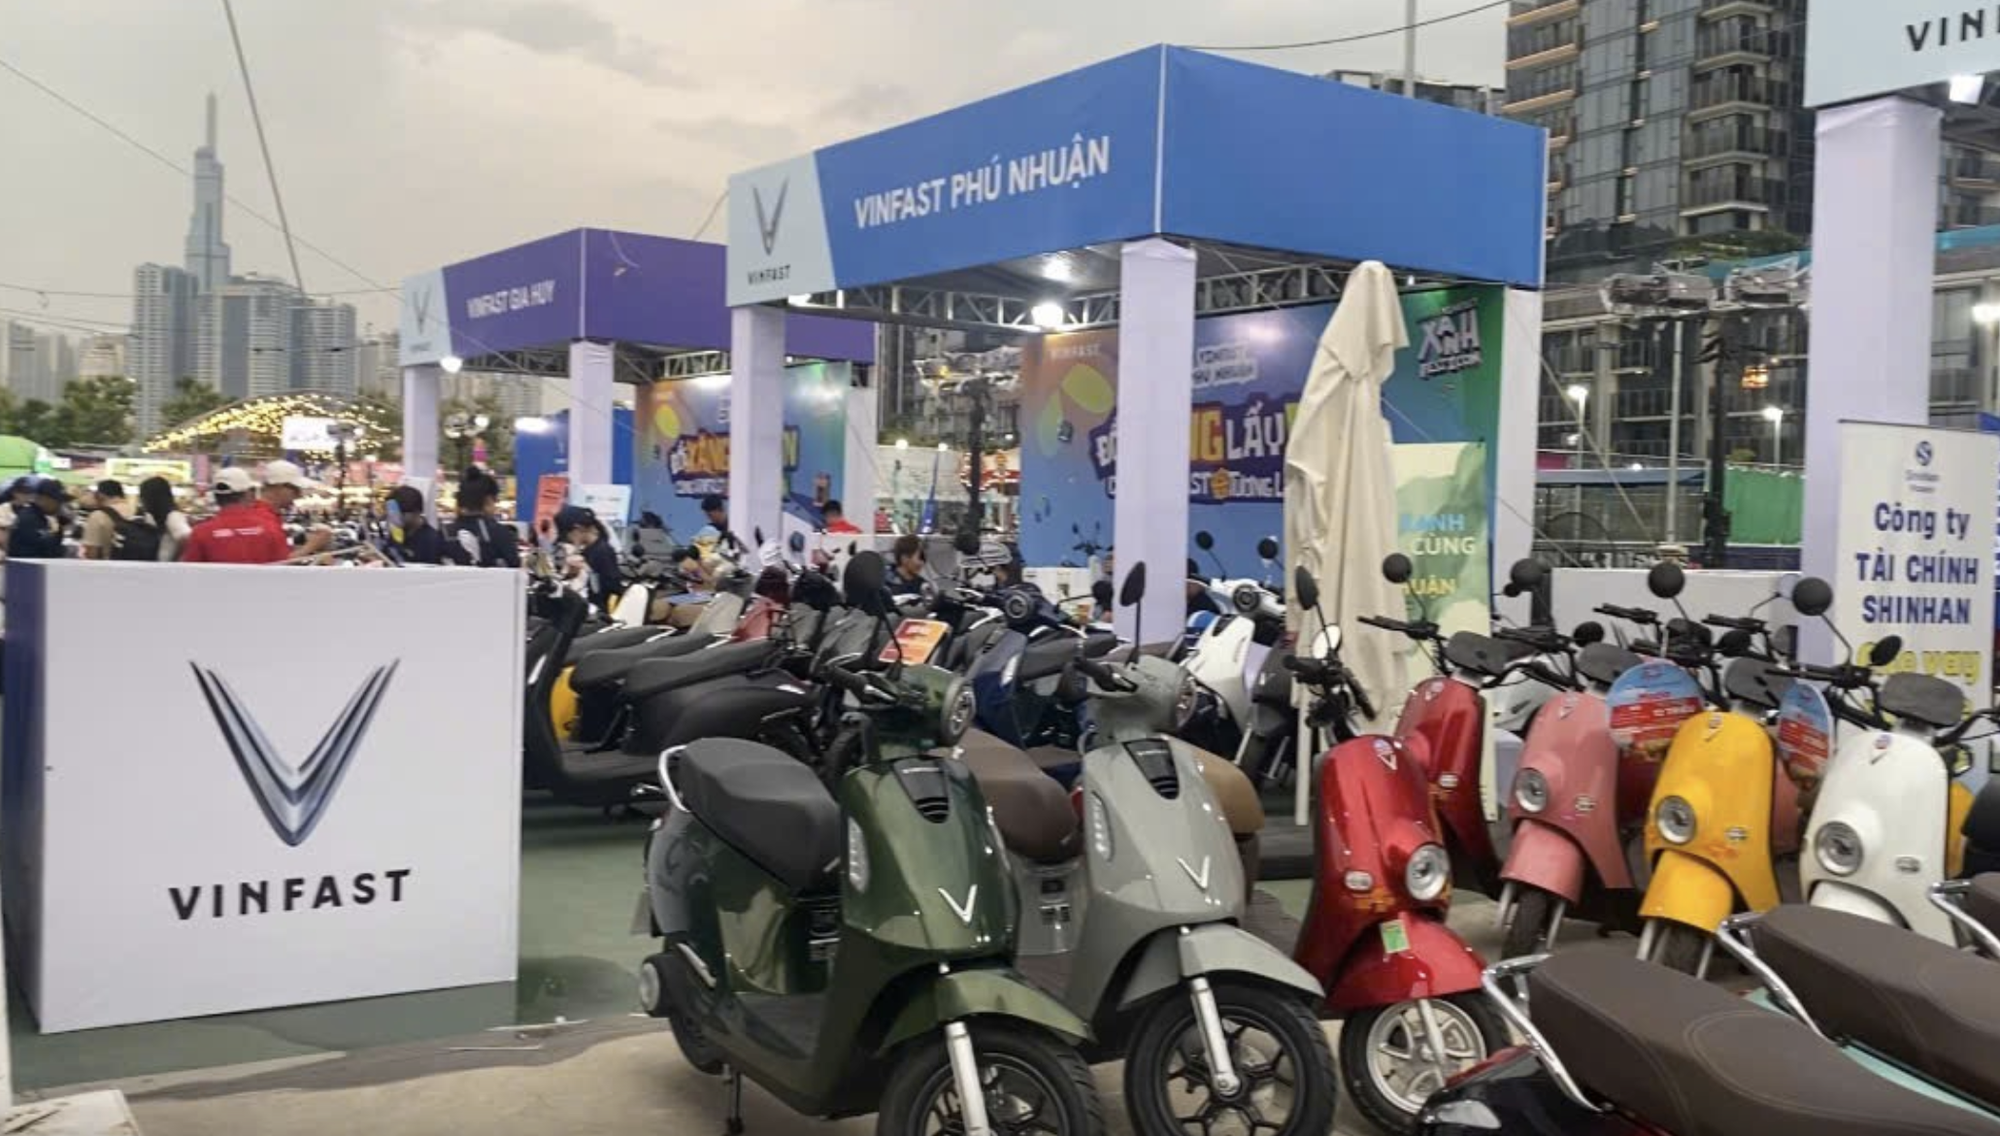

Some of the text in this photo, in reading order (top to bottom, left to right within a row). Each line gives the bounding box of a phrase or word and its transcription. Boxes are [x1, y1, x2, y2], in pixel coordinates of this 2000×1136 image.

[1906, 4, 2000, 51] VIN
[855, 132, 1109, 229] VINFAST PHÚ NHUẬN
[1227, 401, 1285, 459] LẤY
[1875, 502, 1970, 540] Công ty
[1413, 532, 1475, 555] CÙNG
[1855, 548, 1978, 584] TÀI CHÍNH
[1863, 595, 1971, 624] SHINHAN
[168, 869, 410, 920] VINFAST
